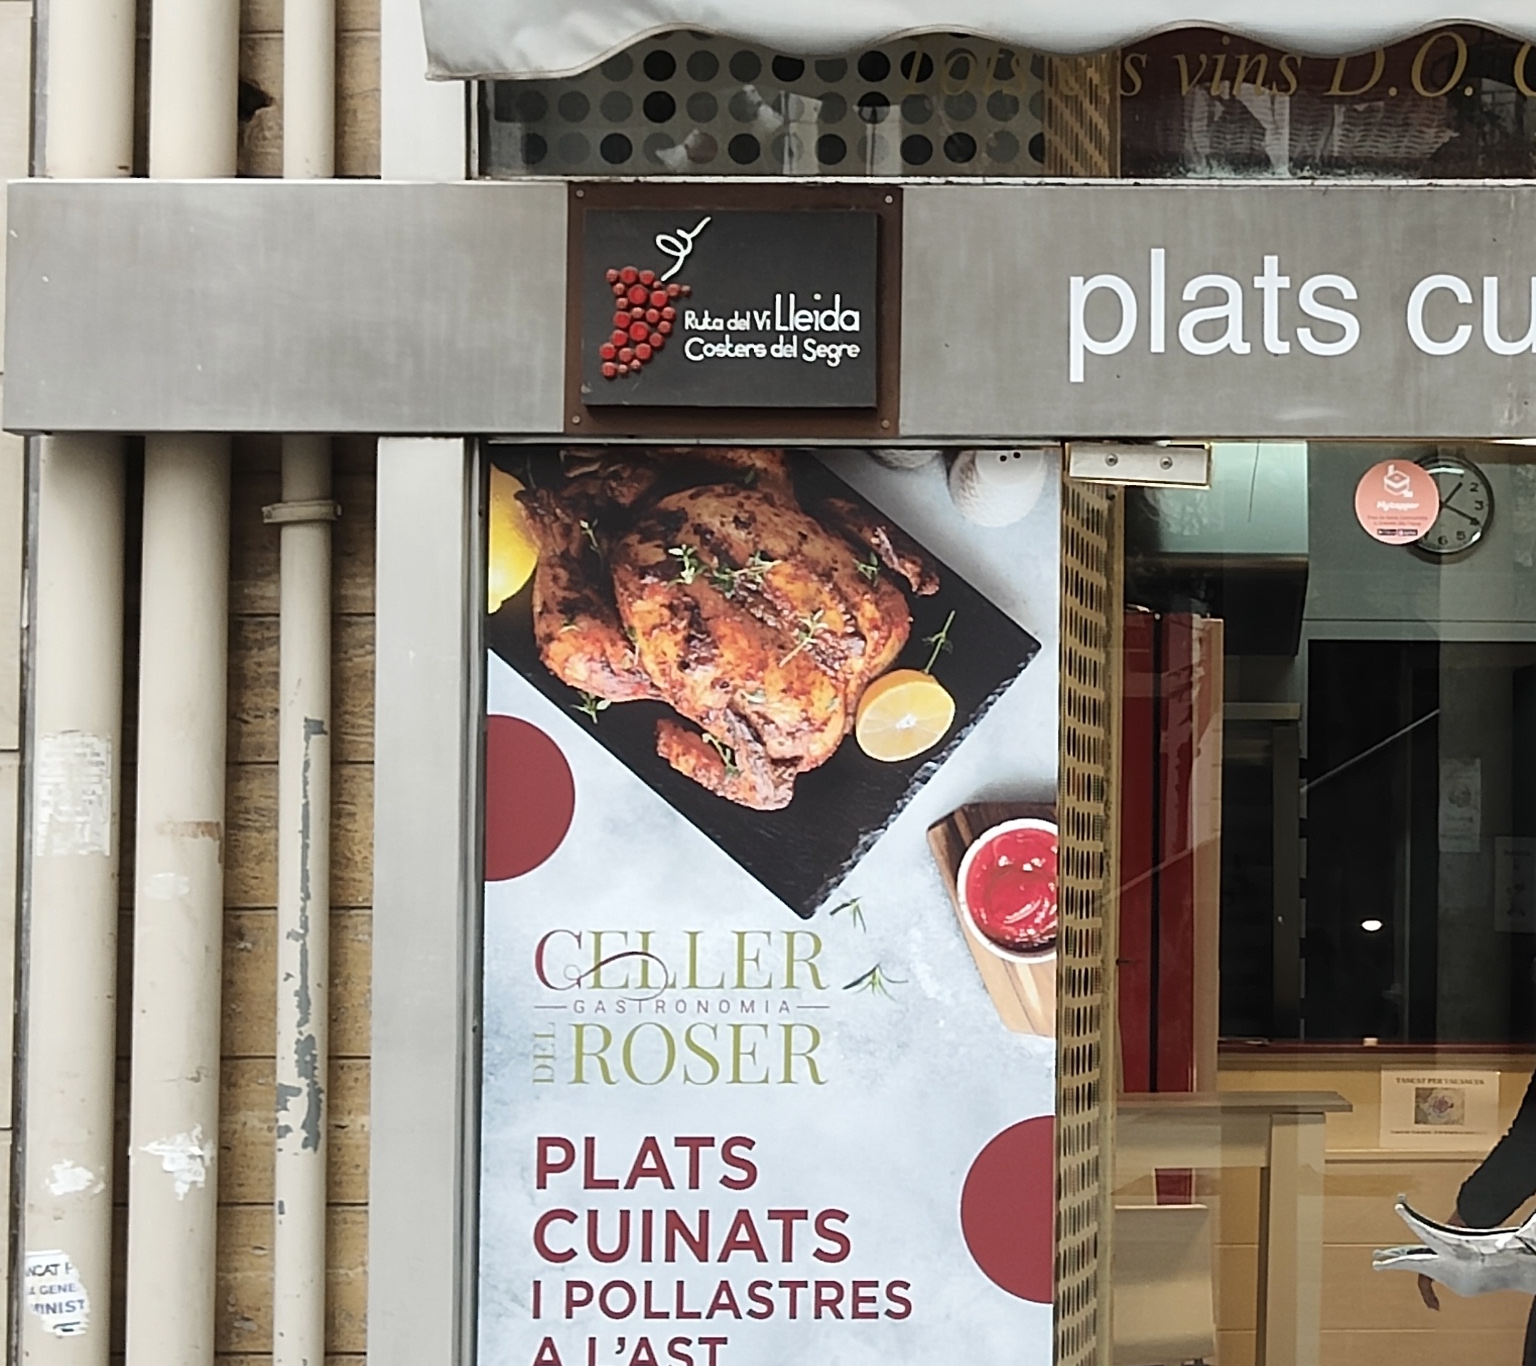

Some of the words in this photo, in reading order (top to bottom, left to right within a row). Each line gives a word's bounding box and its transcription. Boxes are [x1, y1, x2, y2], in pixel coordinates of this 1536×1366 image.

[1174, 34, 1300, 98] vins
[684, 309, 724, 331] Ruta
[727, 310, 750, 331] del
[753, 310, 771, 331] Vi
[775, 293, 860, 332] Lleida
[1067, 247, 1361, 383] plats
[684, 334, 767, 362] Costers
[770, 334, 798, 359] del
[802, 338, 861, 367] Segre
[534, 928, 831, 1001] CELLER
[573, 999, 791, 1015] GASTRONOMIA
[532, 1021, 557, 1084] DEL
[567, 1022, 830, 1086] ROSER
[535, 1136, 759, 1191] PLATS
[533, 1208, 852, 1264] CUINATS
[532, 1280, 541, 1320] I
[564, 1280, 913, 1321] POLLASTRES
